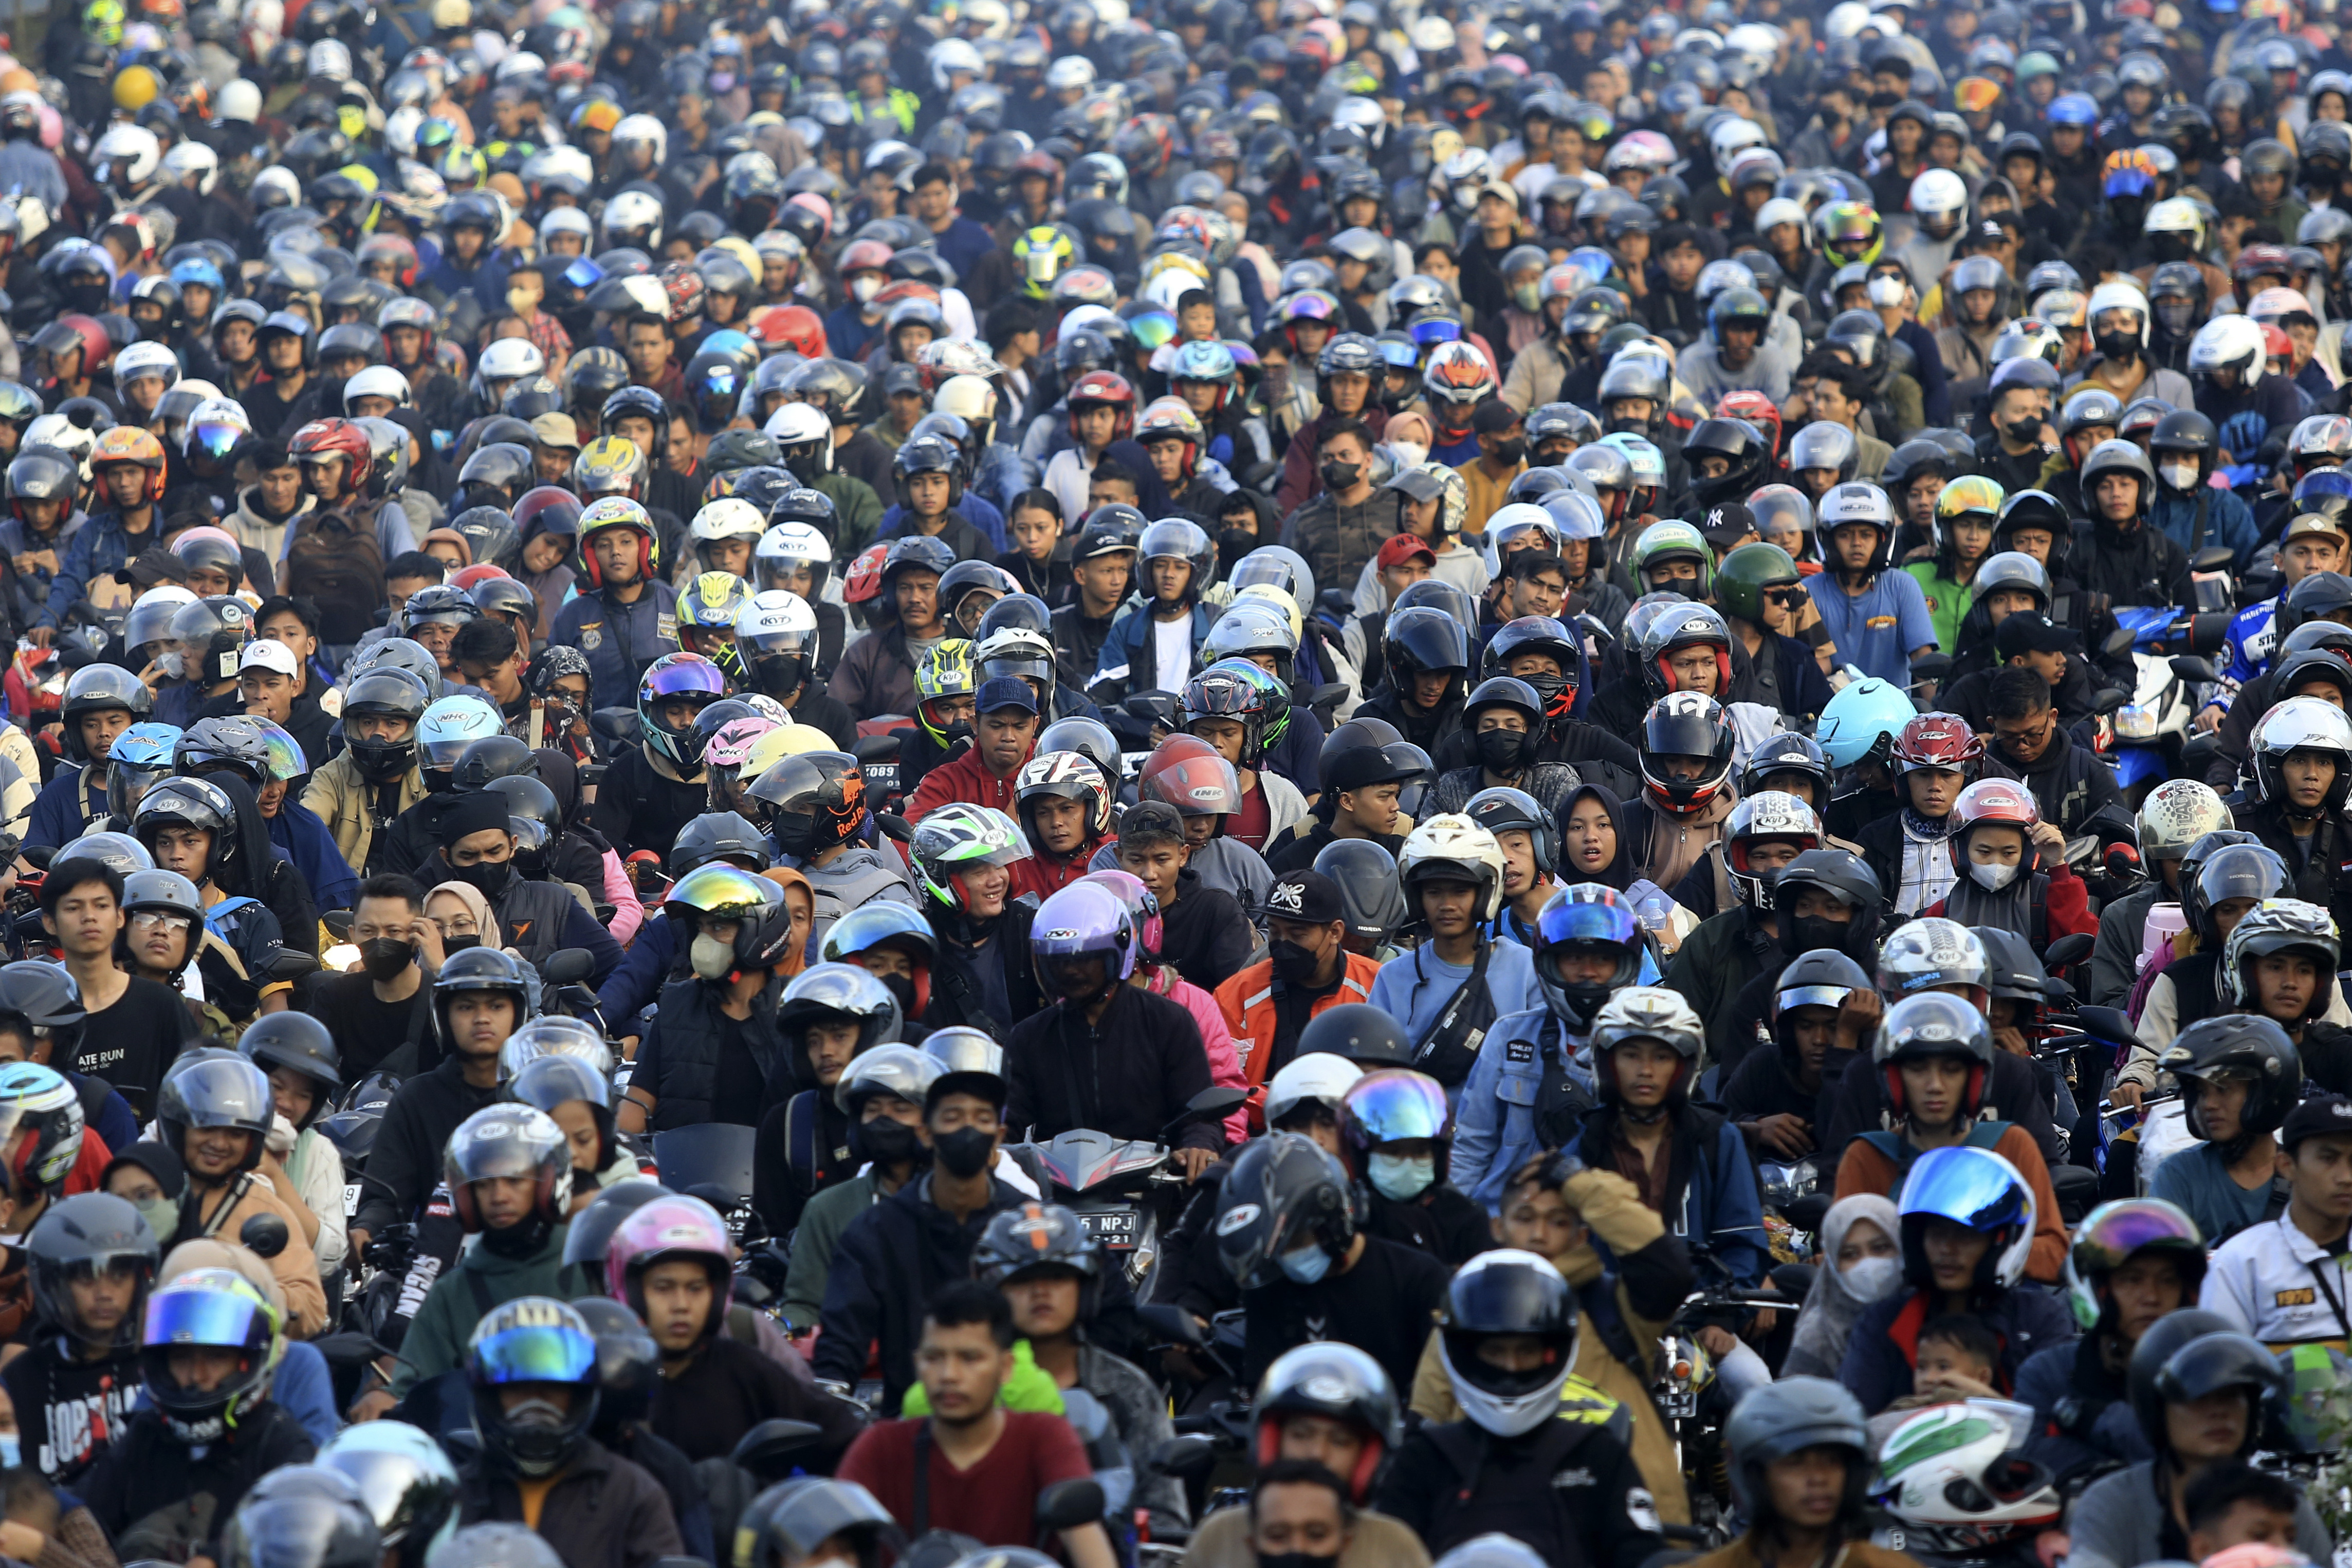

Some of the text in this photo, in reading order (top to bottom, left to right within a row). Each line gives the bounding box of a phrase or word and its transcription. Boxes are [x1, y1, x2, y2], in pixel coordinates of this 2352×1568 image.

[1707, 509, 1723, 527] NY
[943, 672, 958, 682] Kyt
[160, 800, 177, 808] Kyt
[837, 812, 857, 837] Red
[1766, 816, 1782, 825] Kyt
[988, 832, 1002, 842] Kyt
[2177, 827, 2201, 836] GM
[78, 1049, 125, 1066] ATE RUN
[346, 1188, 355, 1201] 9
[1101, 1217, 1133, 1231] NPJ
[2277, 1289, 2312, 1305] 1976
